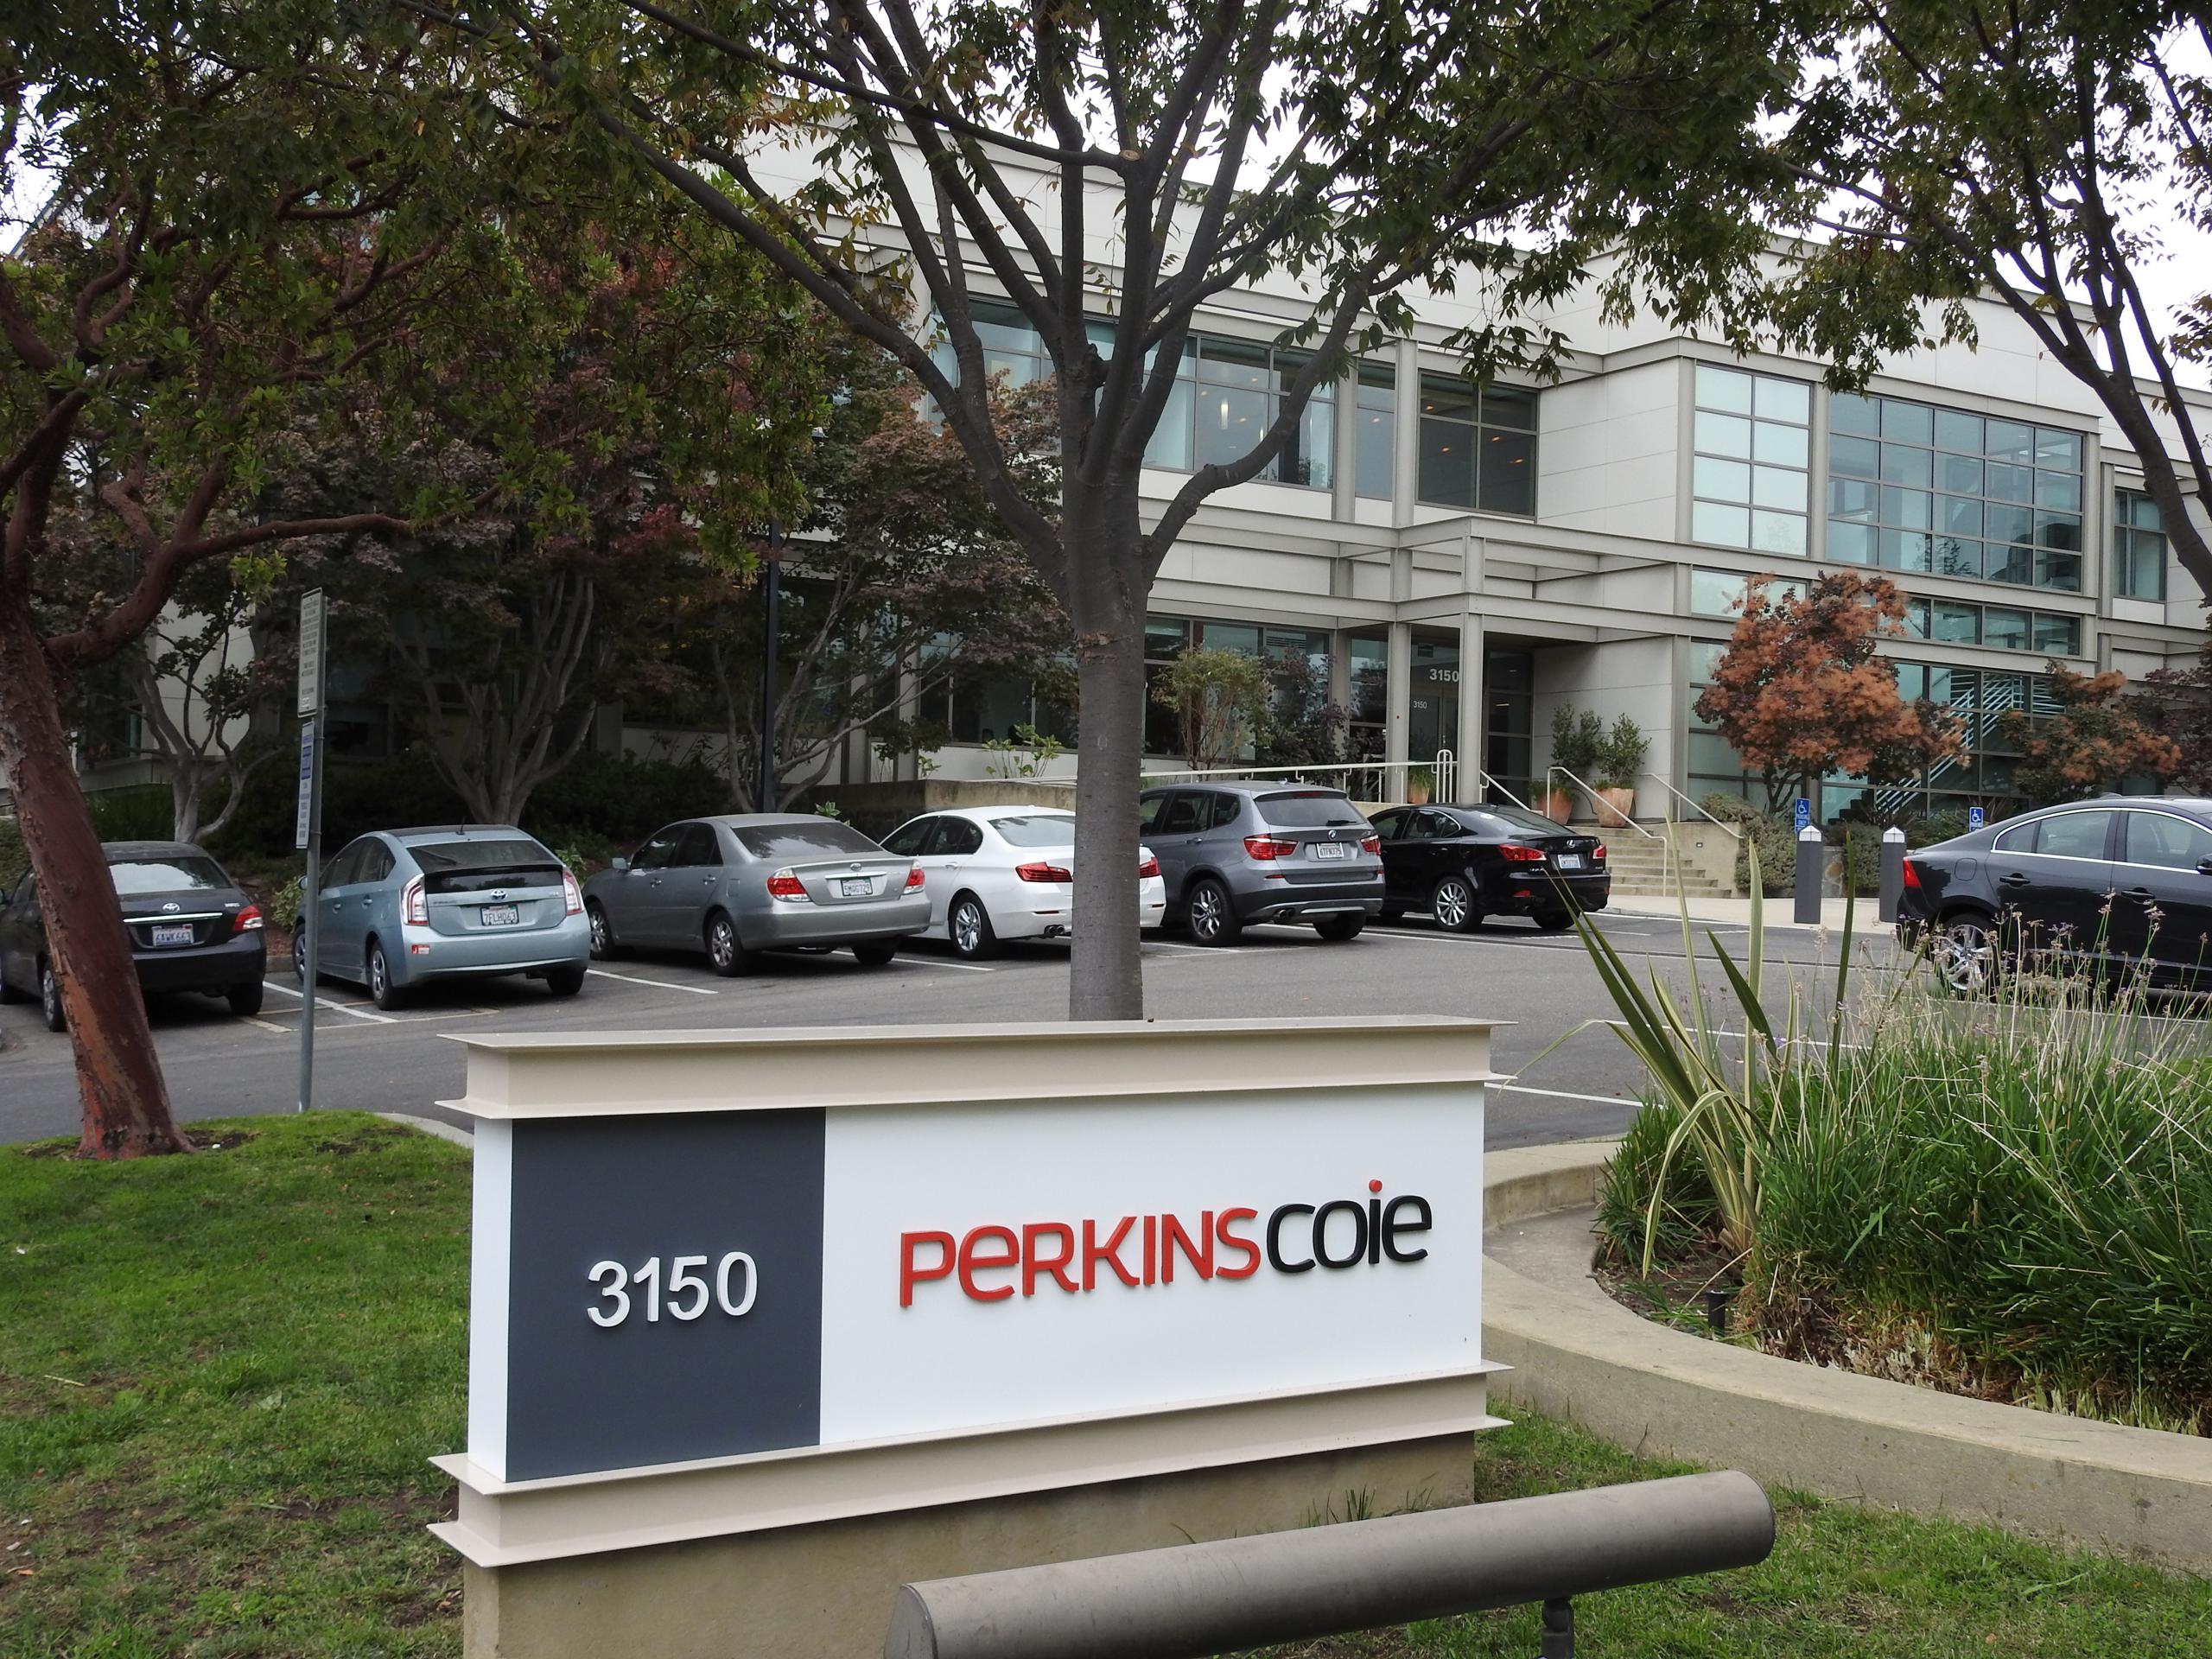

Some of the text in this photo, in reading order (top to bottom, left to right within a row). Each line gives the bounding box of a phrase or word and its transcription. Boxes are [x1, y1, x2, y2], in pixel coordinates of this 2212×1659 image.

[1429, 668, 1459, 683] 3150
[1413, 700, 1427, 709] 3150
[587, 1251, 758, 1327] 3150
